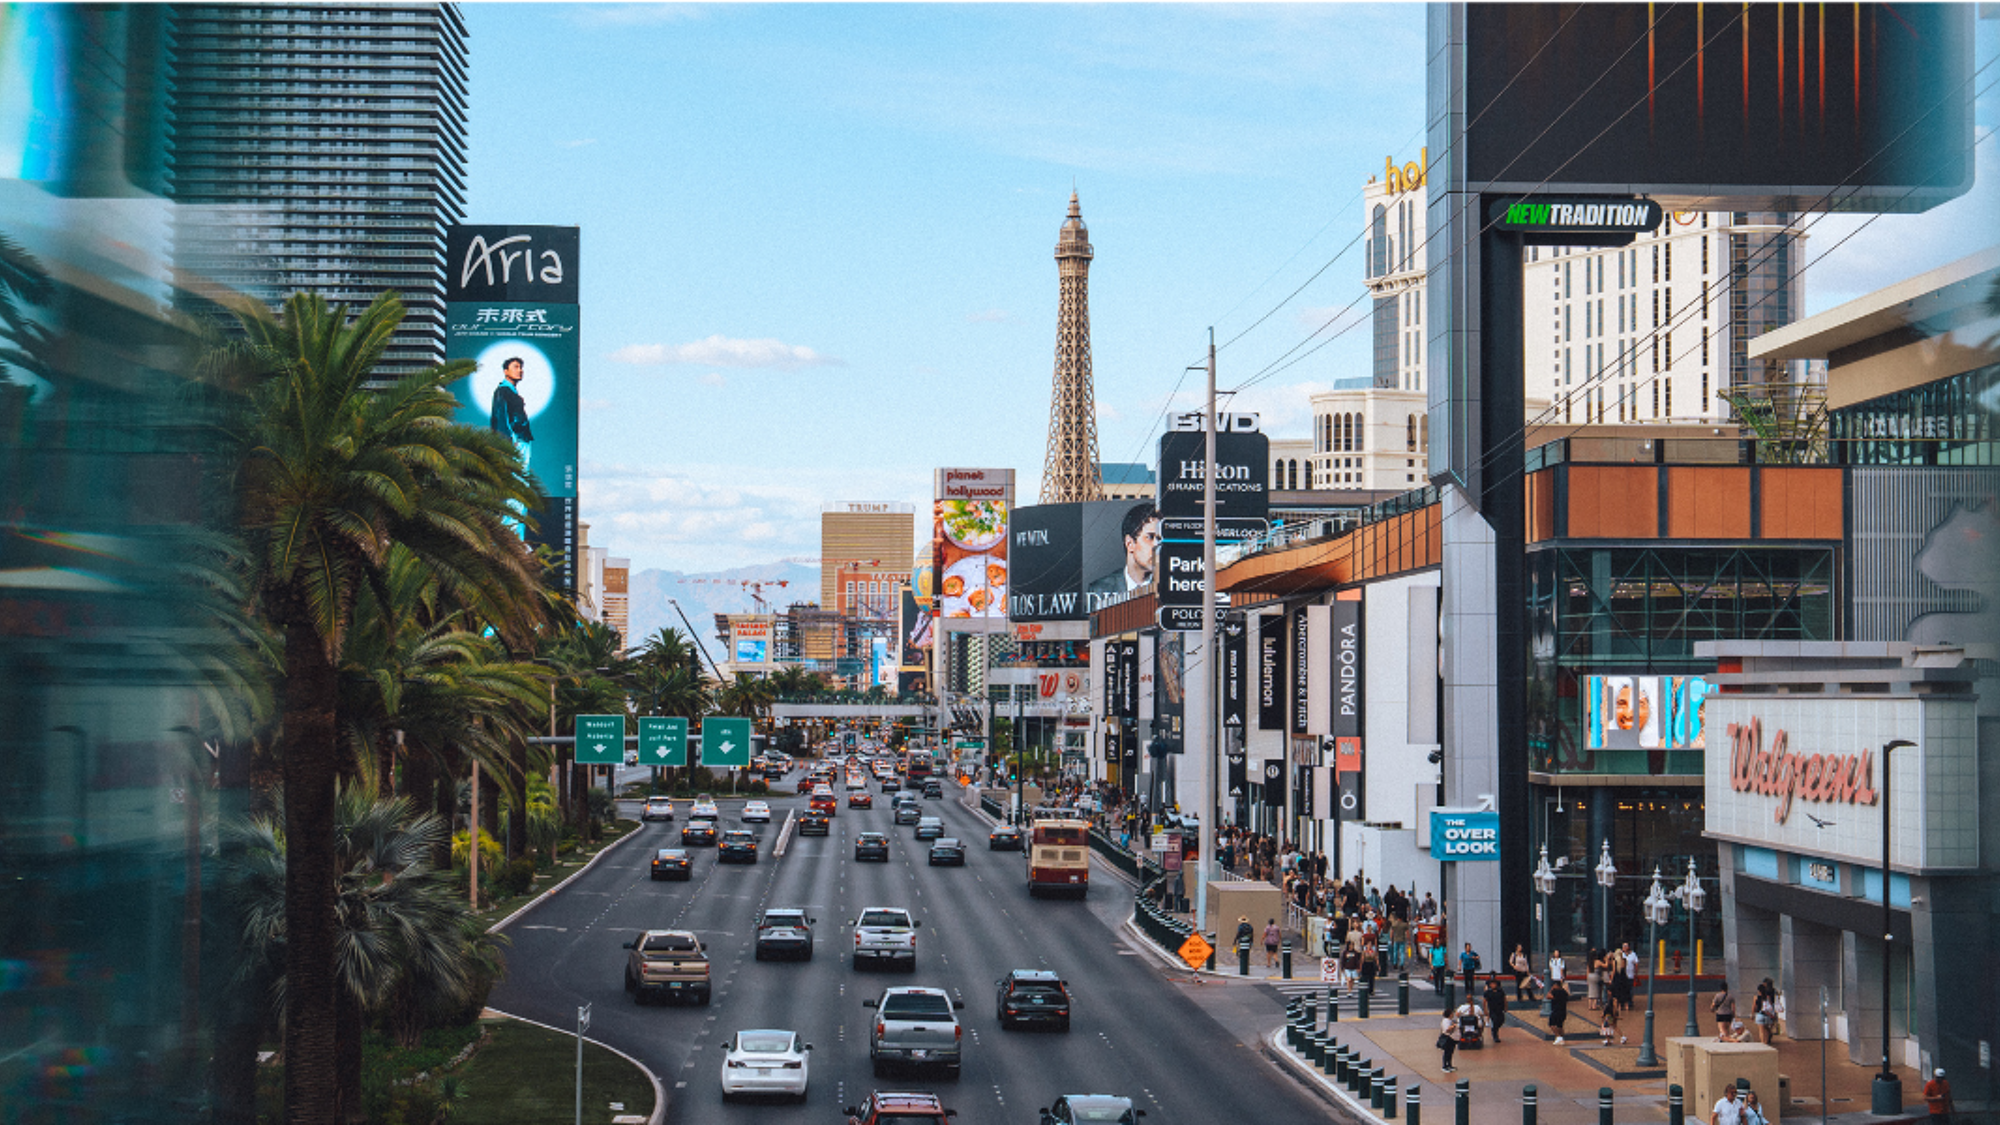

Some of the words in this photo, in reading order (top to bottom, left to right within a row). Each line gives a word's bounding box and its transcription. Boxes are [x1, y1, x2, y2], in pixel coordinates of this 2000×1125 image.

[461, 235, 563, 288] Aria
[947, 468, 985, 483] planet
[1180, 459, 1251, 480] Hiton
[947, 485, 1005, 499] hollywood
[848, 503, 889, 513] TRUMP
[1170, 556, 1205, 572] Park
[1170, 575, 1205, 592] here
[1037, 592, 1078, 616] LAW
[1263, 637, 1277, 707] lululemon
[1339, 623, 1356, 716] PANDORA
[1727, 715, 1876, 823] Walgreens
[1445, 828, 1496, 840] OVER
[1445, 842, 1497, 854] LOOK
